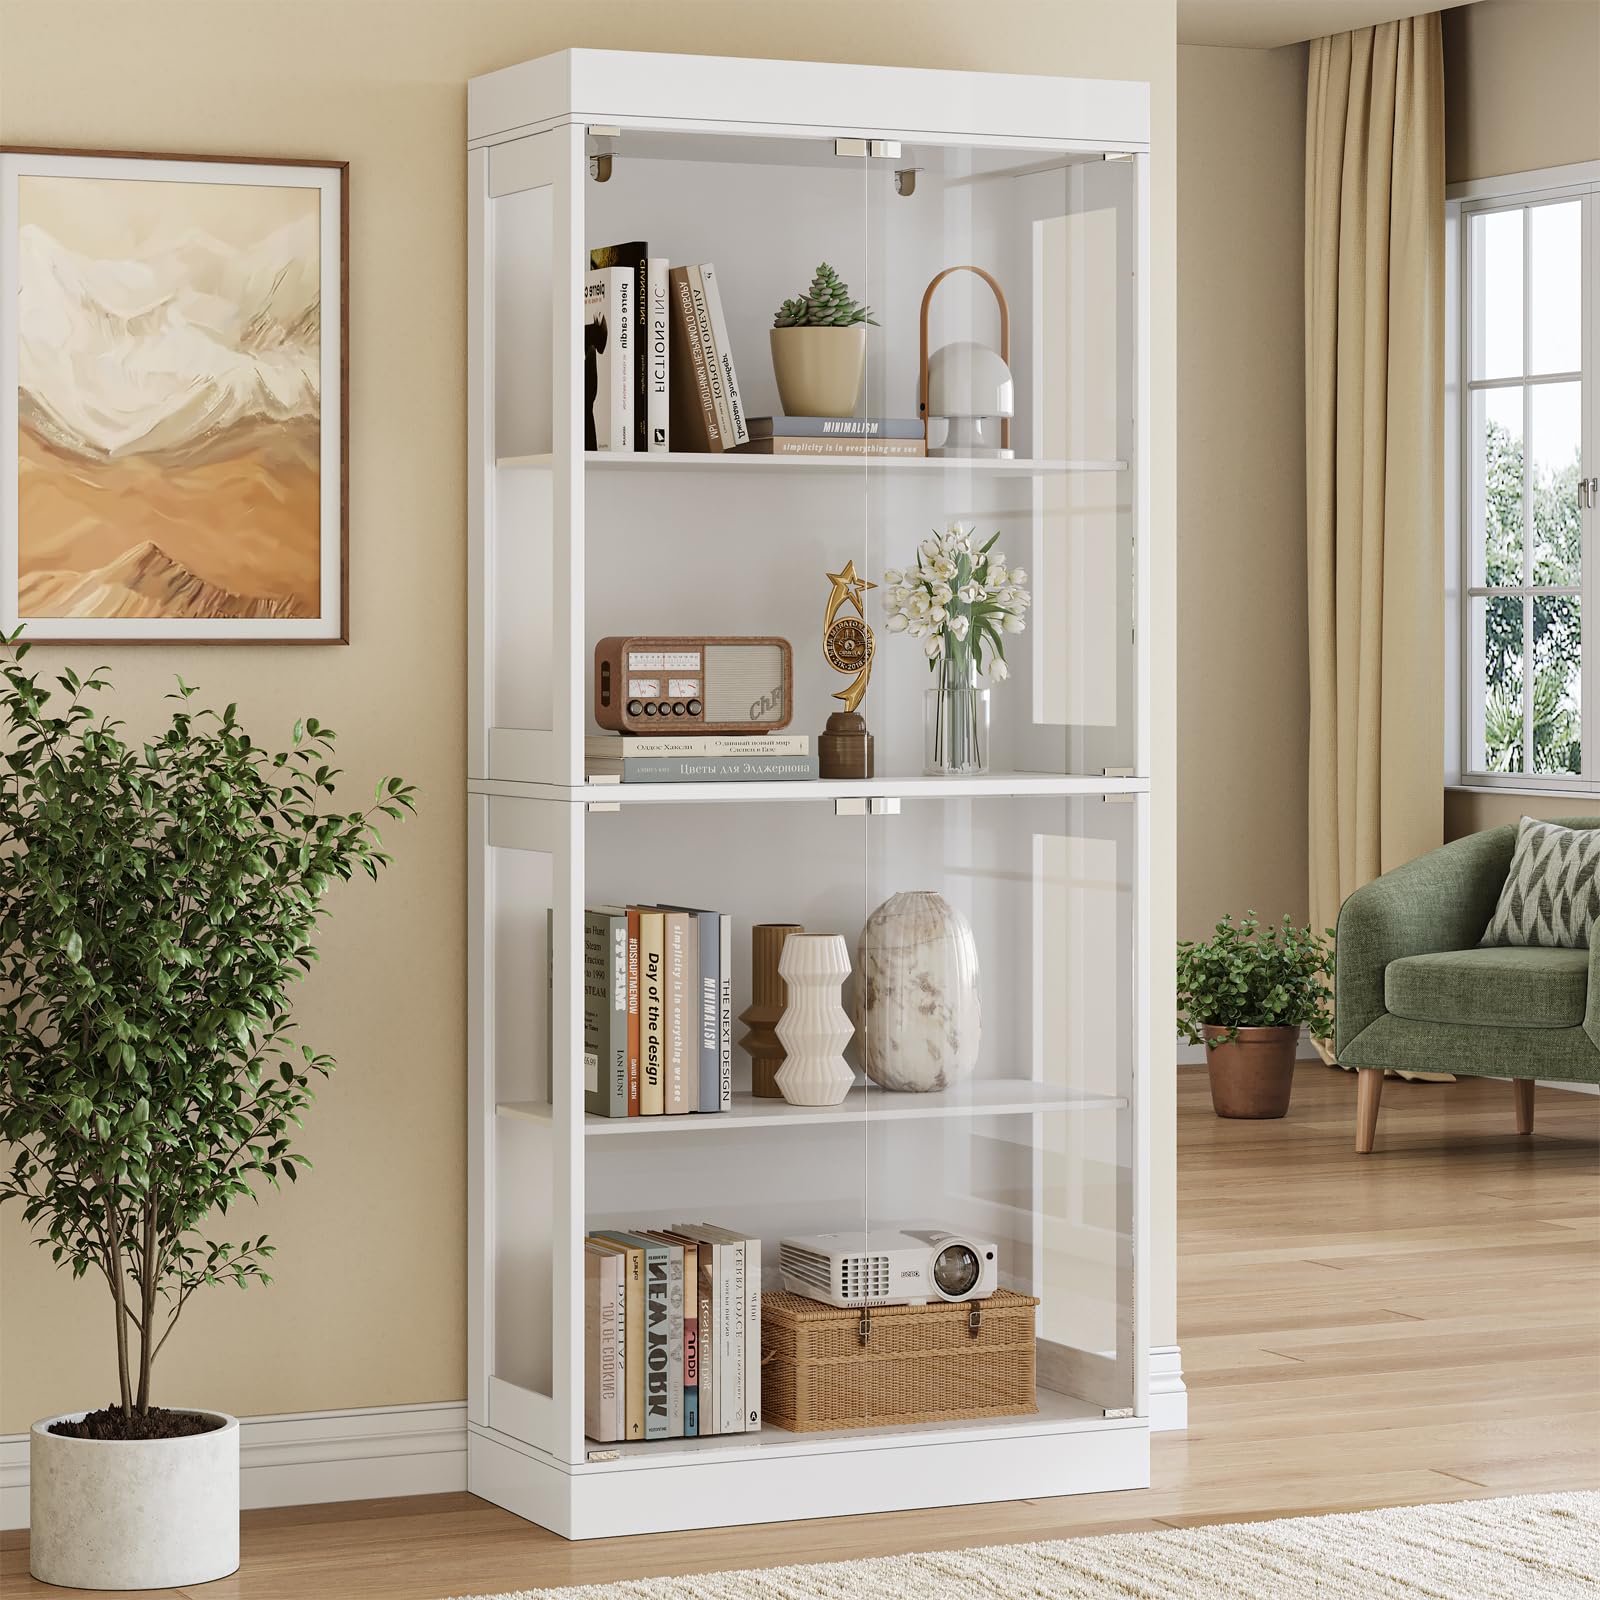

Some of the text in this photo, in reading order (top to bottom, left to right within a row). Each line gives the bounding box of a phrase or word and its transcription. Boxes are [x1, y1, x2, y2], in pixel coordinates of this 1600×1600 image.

[783, 442, 824, 453] simplicity
[825, 443, 833, 452] is
[835, 443, 843, 452] in
[845, 444, 888, 455] everything
[822, 421, 879, 434] MINIMALISM
[680, 763, 810, 775] Цветы для Элджернона
[615, 928, 627, 1011] STEAM
[629, 938, 638, 1015] #DISRUPTMENOW
[645, 952, 660, 1086] Day of the design
[672, 925, 683, 1102] simplicity is in everything we see
[703, 977, 716, 1050] MINIMALISM
[722, 978, 730, 1101] THE NEXT DESIGN
